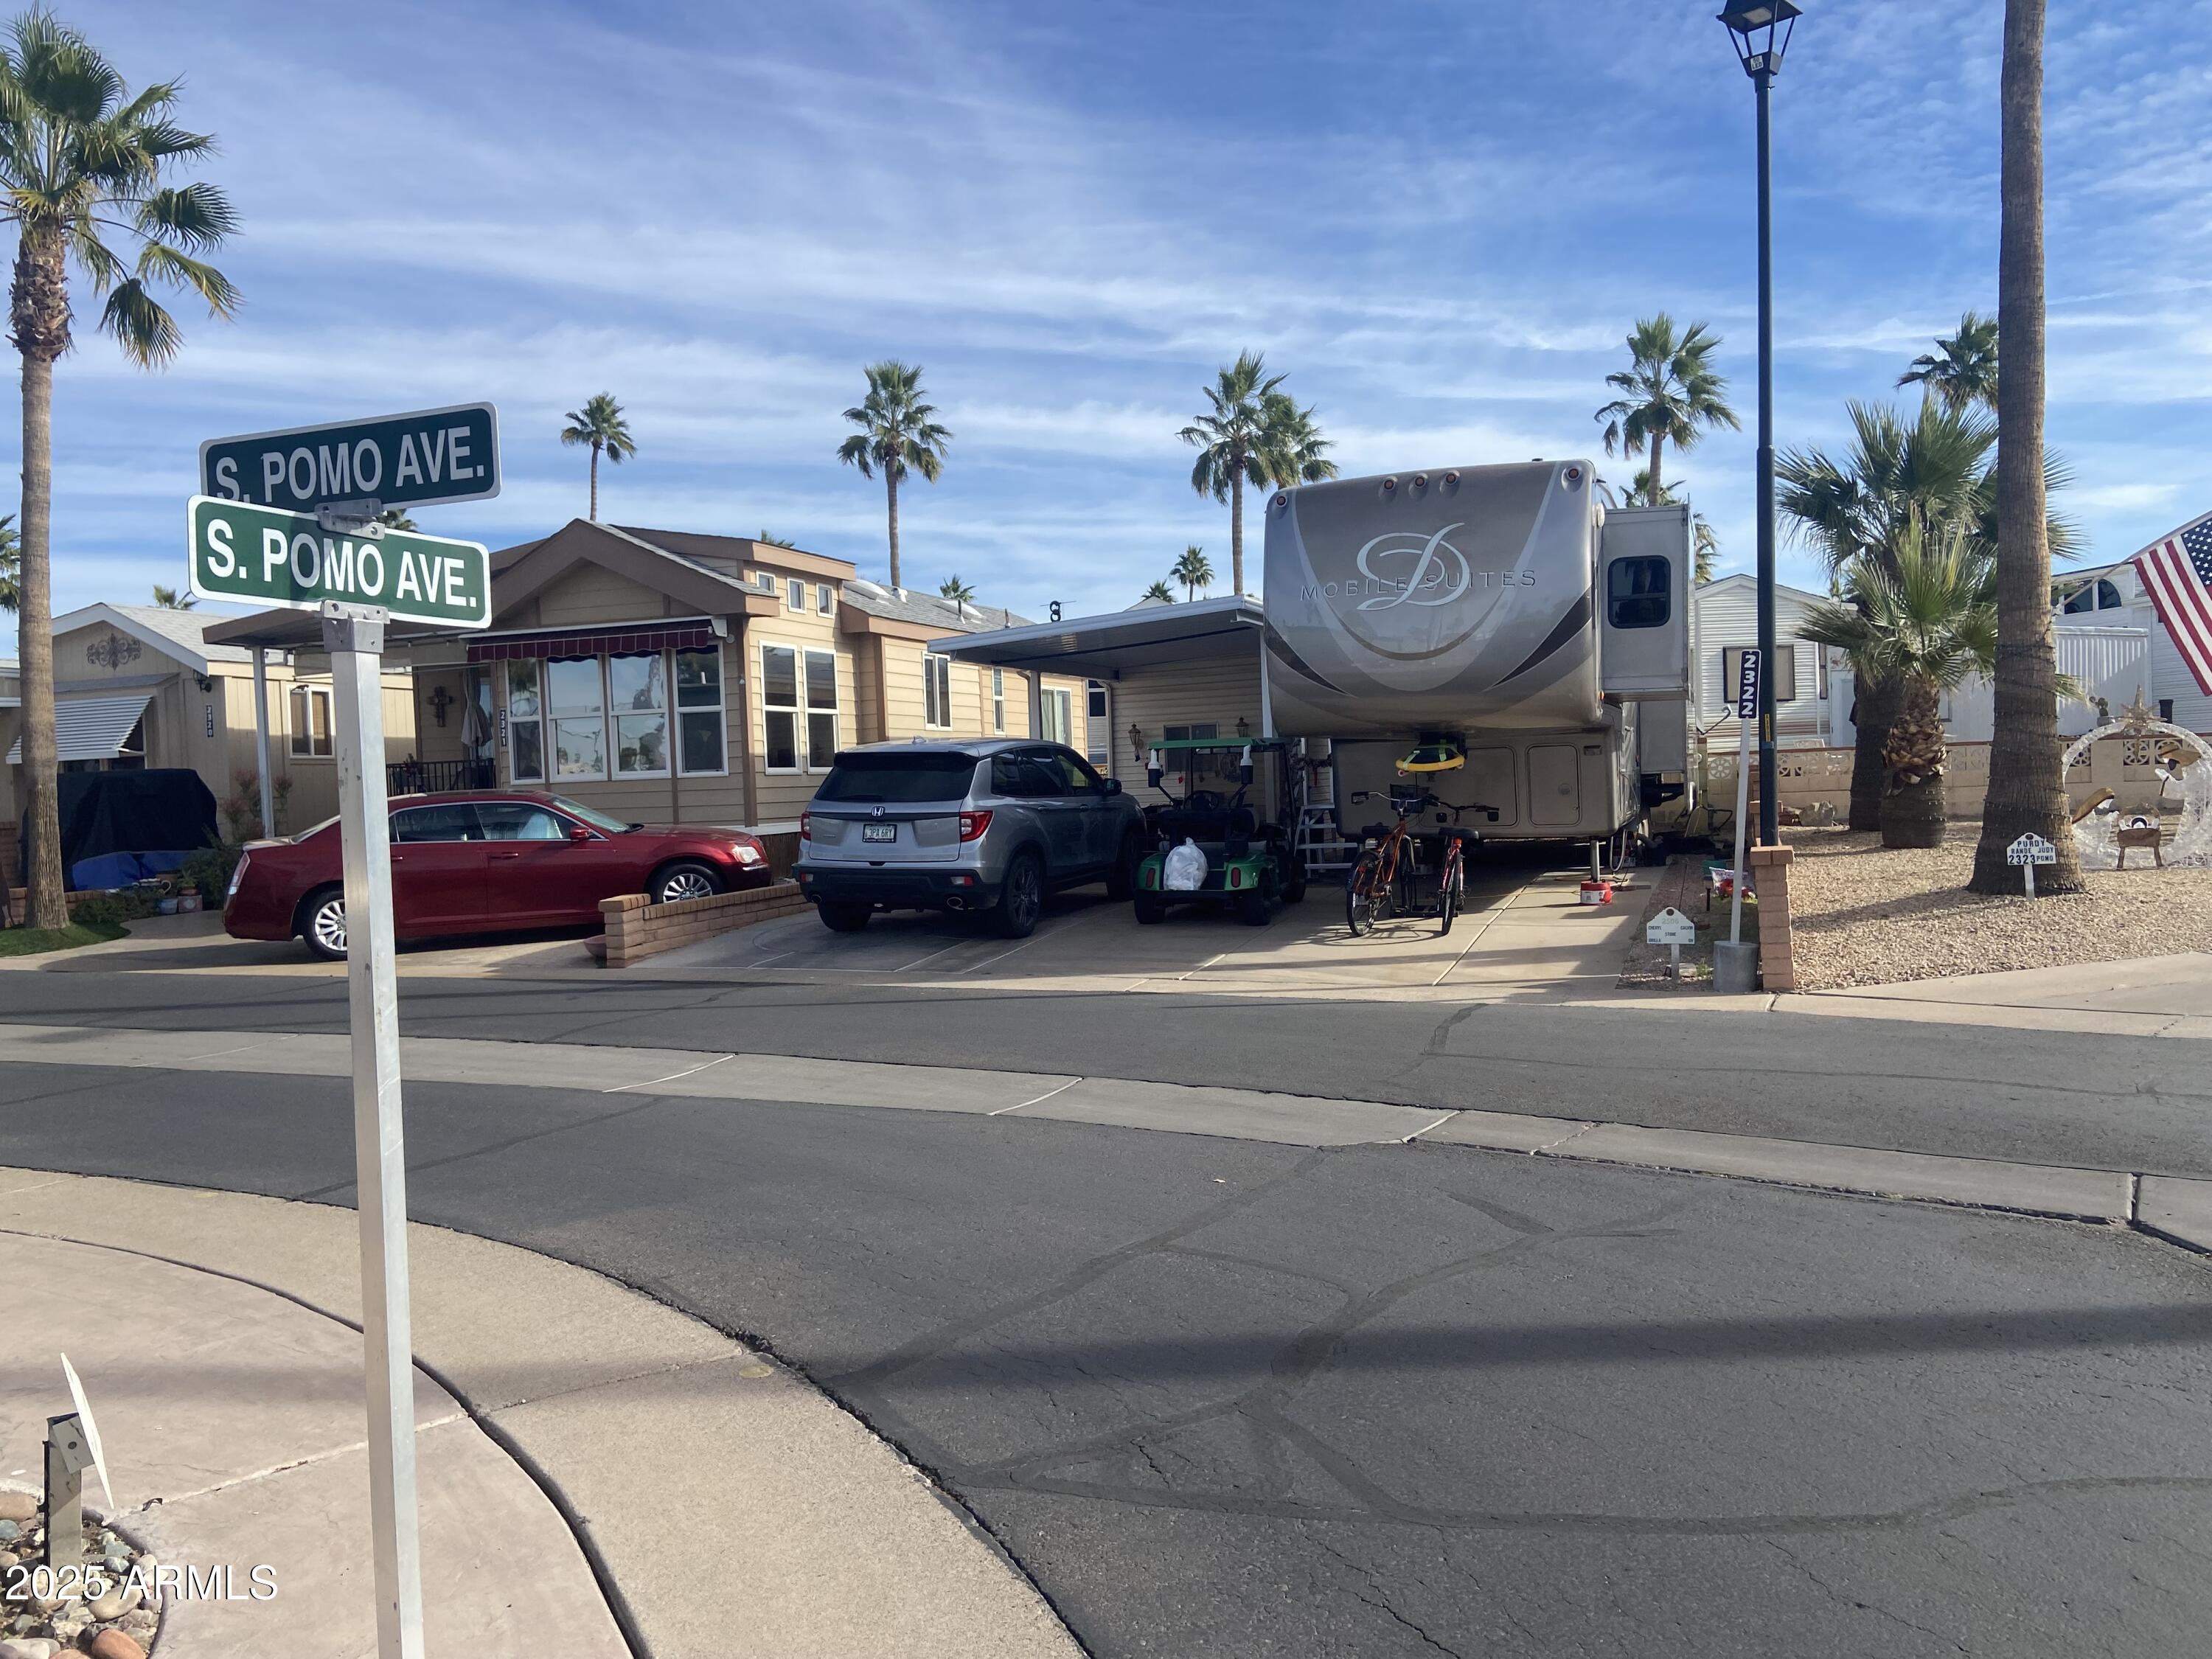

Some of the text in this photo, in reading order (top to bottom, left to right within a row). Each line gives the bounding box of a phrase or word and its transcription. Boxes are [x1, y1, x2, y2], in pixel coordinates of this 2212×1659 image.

[216, 425, 484, 503] S. POMO AVE.
[206, 518, 477, 608] S. POMO AVE.
[1300, 570, 1536, 602] MOBILE SUITES
[1741, 654, 1756, 715] 2322
[2008, 855, 2036, 864] 2323
